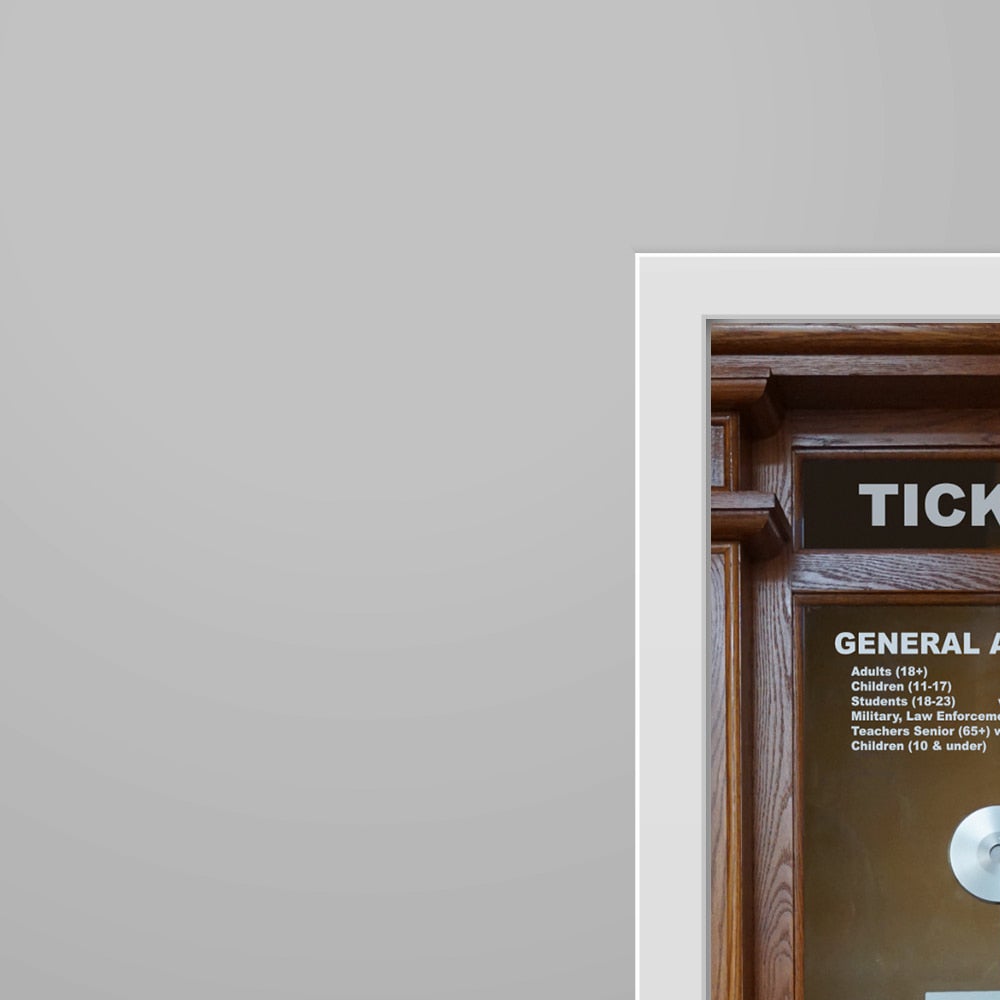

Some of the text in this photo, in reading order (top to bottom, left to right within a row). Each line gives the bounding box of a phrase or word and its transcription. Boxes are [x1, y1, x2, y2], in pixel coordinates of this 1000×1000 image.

[835, 632, 980, 654] GENERAL
[851, 666, 927, 679] Adults (18+)
[851, 681, 951, 693] Children (11-17)
[851, 696, 908, 706] Students
[912, 696, 955, 708] (18-23)
[852, 711, 902, 723] Military,
[907, 711, 933, 721] Law
[851, 726, 910, 736] Teachers
[914, 726, 955, 736] Senior
[959, 726, 990, 738] (65+)
[851, 741, 986, 753] Children (10 & under)
